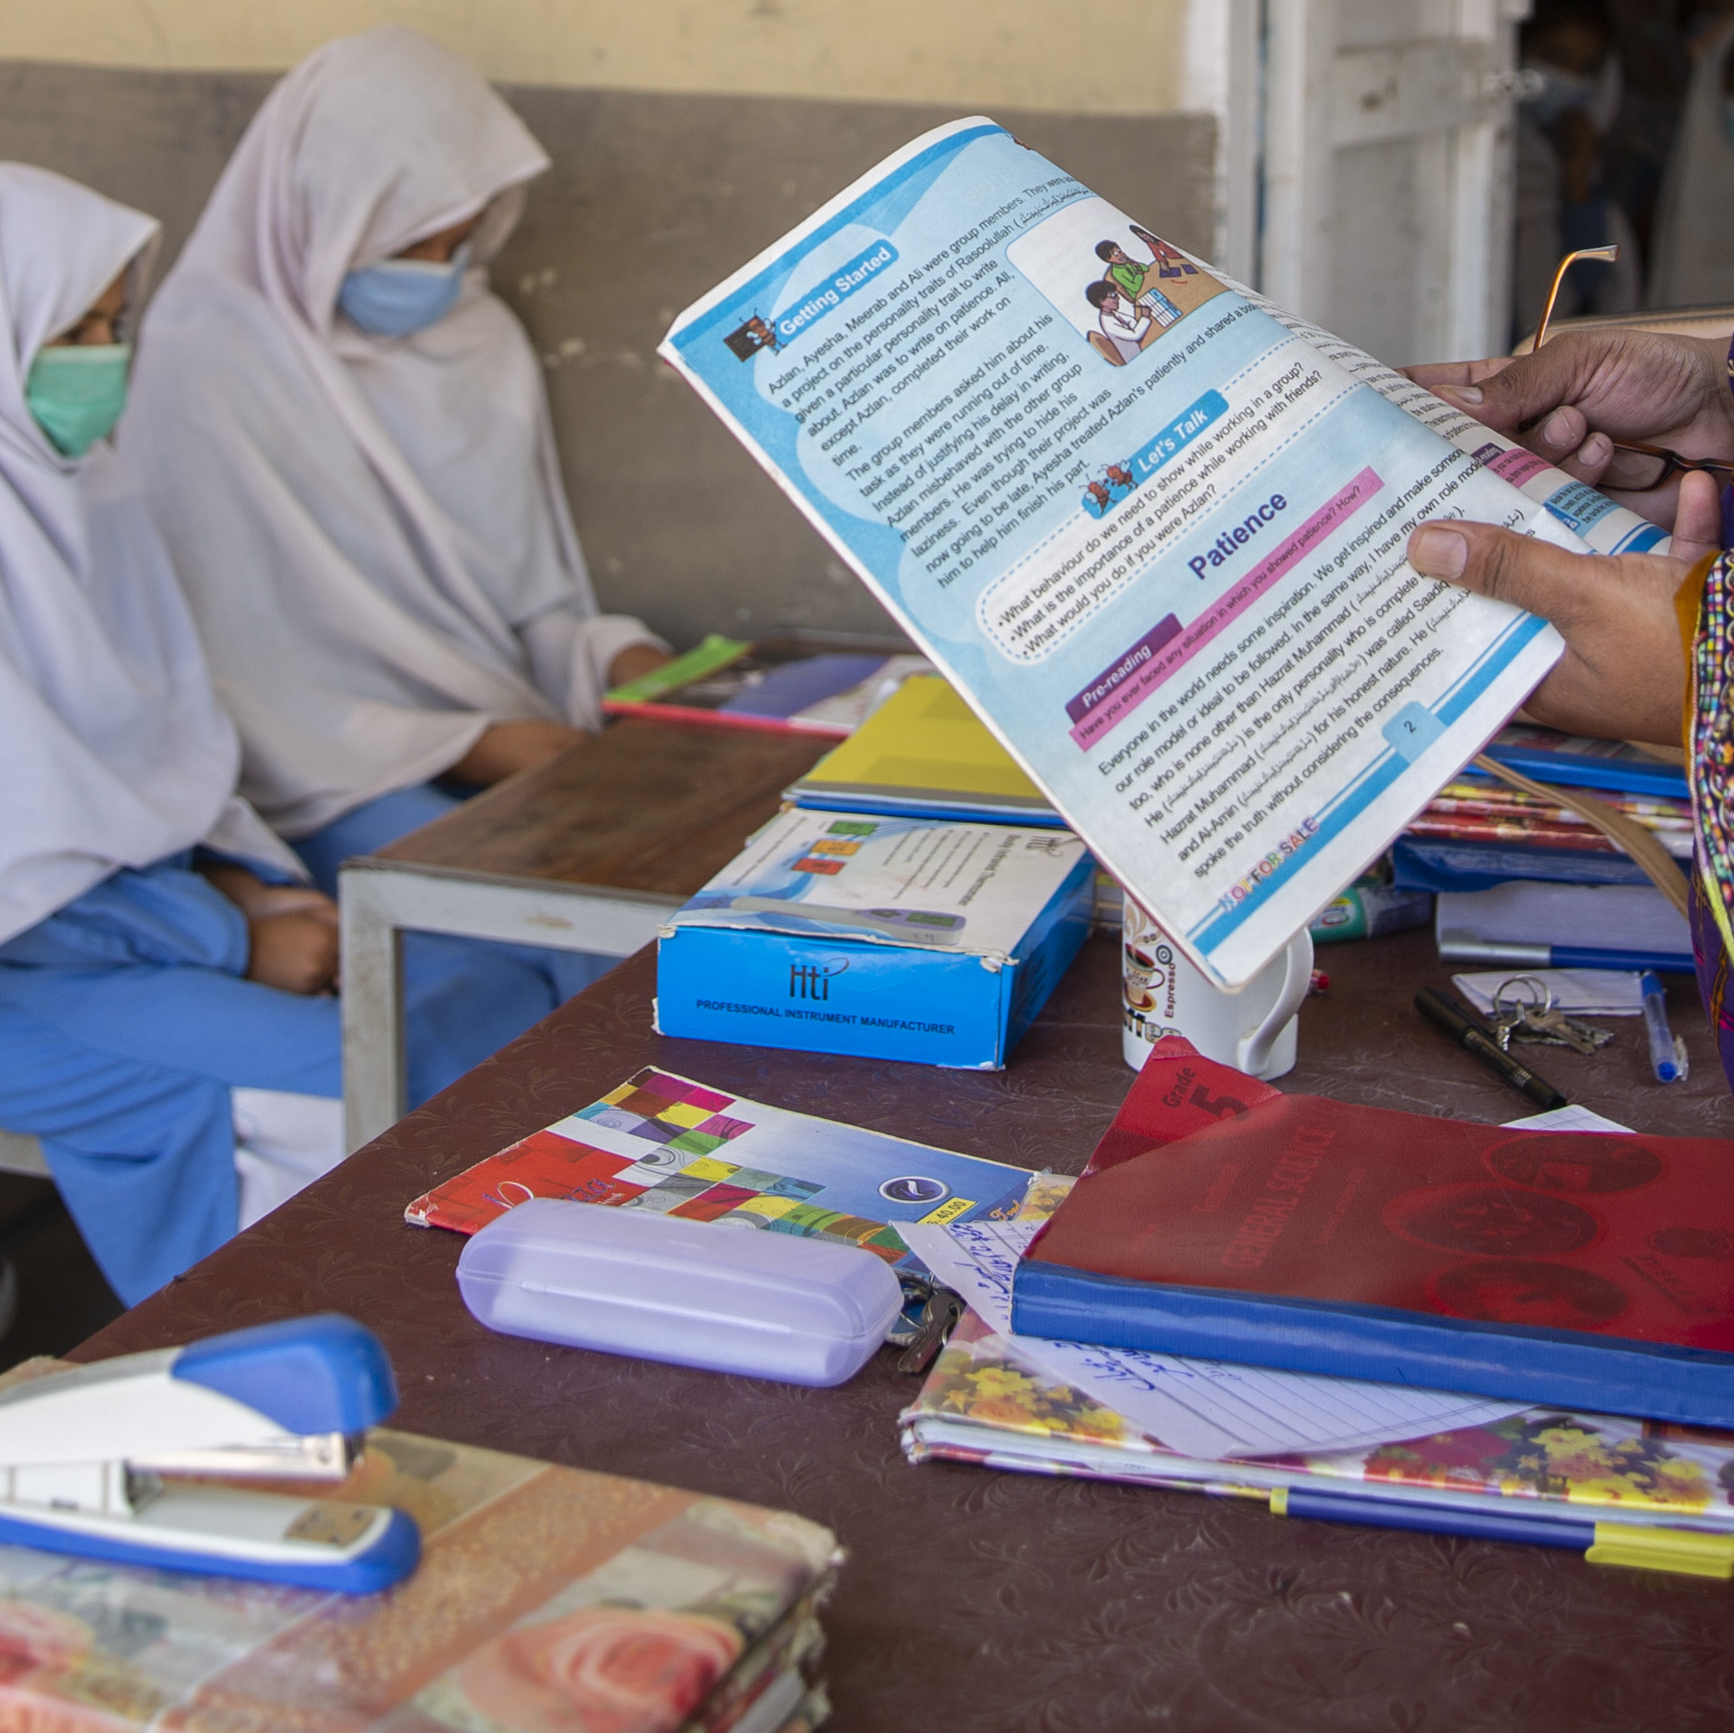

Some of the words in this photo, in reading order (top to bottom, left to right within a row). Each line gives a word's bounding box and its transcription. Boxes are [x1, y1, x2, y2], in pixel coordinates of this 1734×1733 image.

[768, 366, 804, 394] Azlan,
[802, 332, 848, 366] Ayesha,
[844, 298, 887, 331] Meerab
[887, 279, 909, 300] and
[907, 269, 924, 284] Ali
[922, 250, 949, 271] were
[949, 227, 979, 254] group
[978, 197, 1023, 230] members.
[1021, 183, 1048, 197] They
[1045, 177, 1065, 187] were
[779, 289, 839, 342] Getting
[835, 246, 895, 300] Started
[793, 395, 825, 424] given
[824, 387, 835, 398] a
[834, 348, 882, 392] particular
[883, 304, 940, 353] personality
[937, 286, 962, 306] trait
[958, 278, 973, 290] to
[971, 259, 998, 280] write
[845, 462, 871, 480] The
[870, 435, 903, 466] group
[902, 395, 953, 438] members
[953, 366, 985, 397] asked
[982, 351, 1006, 371] him
[1005, 326, 1037, 354] about
[1033, 313, 1053, 330] his
[925, 549, 950, 572] now
[949, 523, 983, 554] going
[979, 513, 993, 526] to
[991, 500, 1009, 516] be
[1006, 483, 1034, 502] late,
[1031, 447, 1072, 483] Ayesha
[1070, 414, 1109, 449] treated
[1107, 386, 1145, 420] Azlan's
[1144, 351, 1186, 390] patiently
[1185, 333, 1206, 354] and
[1204, 311, 1236, 338] shared
[1233, 309, 1243, 317] a
[1137, 437, 1175, 472] Let's
[1173, 409, 1207, 439] Talk
[1000, 594, 1033, 623] What
[1030, 550, 1084, 598] behaviour
[1084, 537, 1101, 553] do
[1099, 523, 1118, 539] we
[1117, 497, 1145, 525] need
[1143, 488, 1157, 501] to
[1156, 464, 1185, 491] show
[1184, 440, 1213, 466] while
[1212, 405, 1255, 442] working
[1250, 396, 1264, 408] in
[1263, 389, 1273, 399] a
[1271, 361, 1303, 393] group?
[1012, 609, 1046, 637] What
[1044, 600, 1057, 613] is
[1054, 584, 1075, 603] the
[1074, 534, 1133, 586] importance
[1132, 520, 1145, 536] of
[1144, 516, 1155, 526] a
[1153, 478, 1198, 520] patience
[1197, 454, 1226, 479] while
[1224, 418, 1267, 455] working
[1264, 400, 1287, 420] with
[1284, 369, 1322, 403] friends?
[1188, 494, 1286, 579] Patience
[1024, 623, 1058, 651] What
[1056, 594, 1090, 626] would
[1089, 577, 1112, 601] you
[1110, 564, 1127, 580] do
[1125, 553, 1135, 567] if
[1134, 539, 1156, 562] you
[1154, 516, 1182, 541] were
[1180, 483, 1216, 519] Azlan?
[1098, 730, 1149, 775] Everyone
[1147, 719, 1161, 732] in
[1158, 704, 1178, 722] the
[1176, 676, 1206, 706] world
[1204, 650, 1237, 681] needs
[1236, 625, 1266, 653] some
[1265, 581, 1314, 627] inspiration.
[1312, 563, 1334, 581] We
[1333, 546, 1351, 568] get
[1348, 512, 1387, 552] inspired
[1385, 496, 1405, 518] and
[1403, 474, 1432, 502] make
[1115, 773, 1133, 792] our
[1133, 755, 1155, 776] role
[1154, 724, 1187, 757] model
[1186, 714, 1198, 729] or
[1198, 690, 1224, 718] ideal
[1221, 682, 1236, 695] to
[1232, 669, 1250, 685] be
[1247, 630, 1291, 671] followed.
[1290, 620, 1305, 633] In
[1302, 605, 1321, 623] the
[1320, 580, 1348, 607] same
[1346, 561, 1372, 582] way,
[1367, 552, 1376, 562] I
[1373, 532, 1401, 557] have
[1400, 517, 1422, 538] my
[1416, 498, 1439, 525] own
[1437, 480, 1459, 500] role
[1082, 645, 1151, 707] Pre-reading
[1128, 792, 1153, 810] too,
[1150, 769, 1175, 791] who
[1173, 759, 1185, 771] is
[1184, 735, 1211, 761] none
[1210, 710, 1237, 737] other
[1235, 690, 1261, 713] than
[1258, 658, 1295, 692] Hazrat
[1291, 606, 1351, 662] Muhammad
[1402, 719, 1417, 734] 2
[1217, 875, 1254, 914] NOT
[1249, 850, 1285, 885] FOR
[1278, 815, 1322, 859] SALE
[695, 999, 782, 1018] PROFESSIONAL
[783, 1009, 858, 1026] INSTRUMENT
[859, 1016, 955, 1035] MANUFACTURER
[1164, 962, 1176, 1018] Espresso
[1162, 1067, 1197, 1108] Grade
[1188, 1084, 1250, 1121] 5
[1222, 1197, 1300, 1269] GENERAL
[1267, 1124, 1336, 1194] SCIENCE
